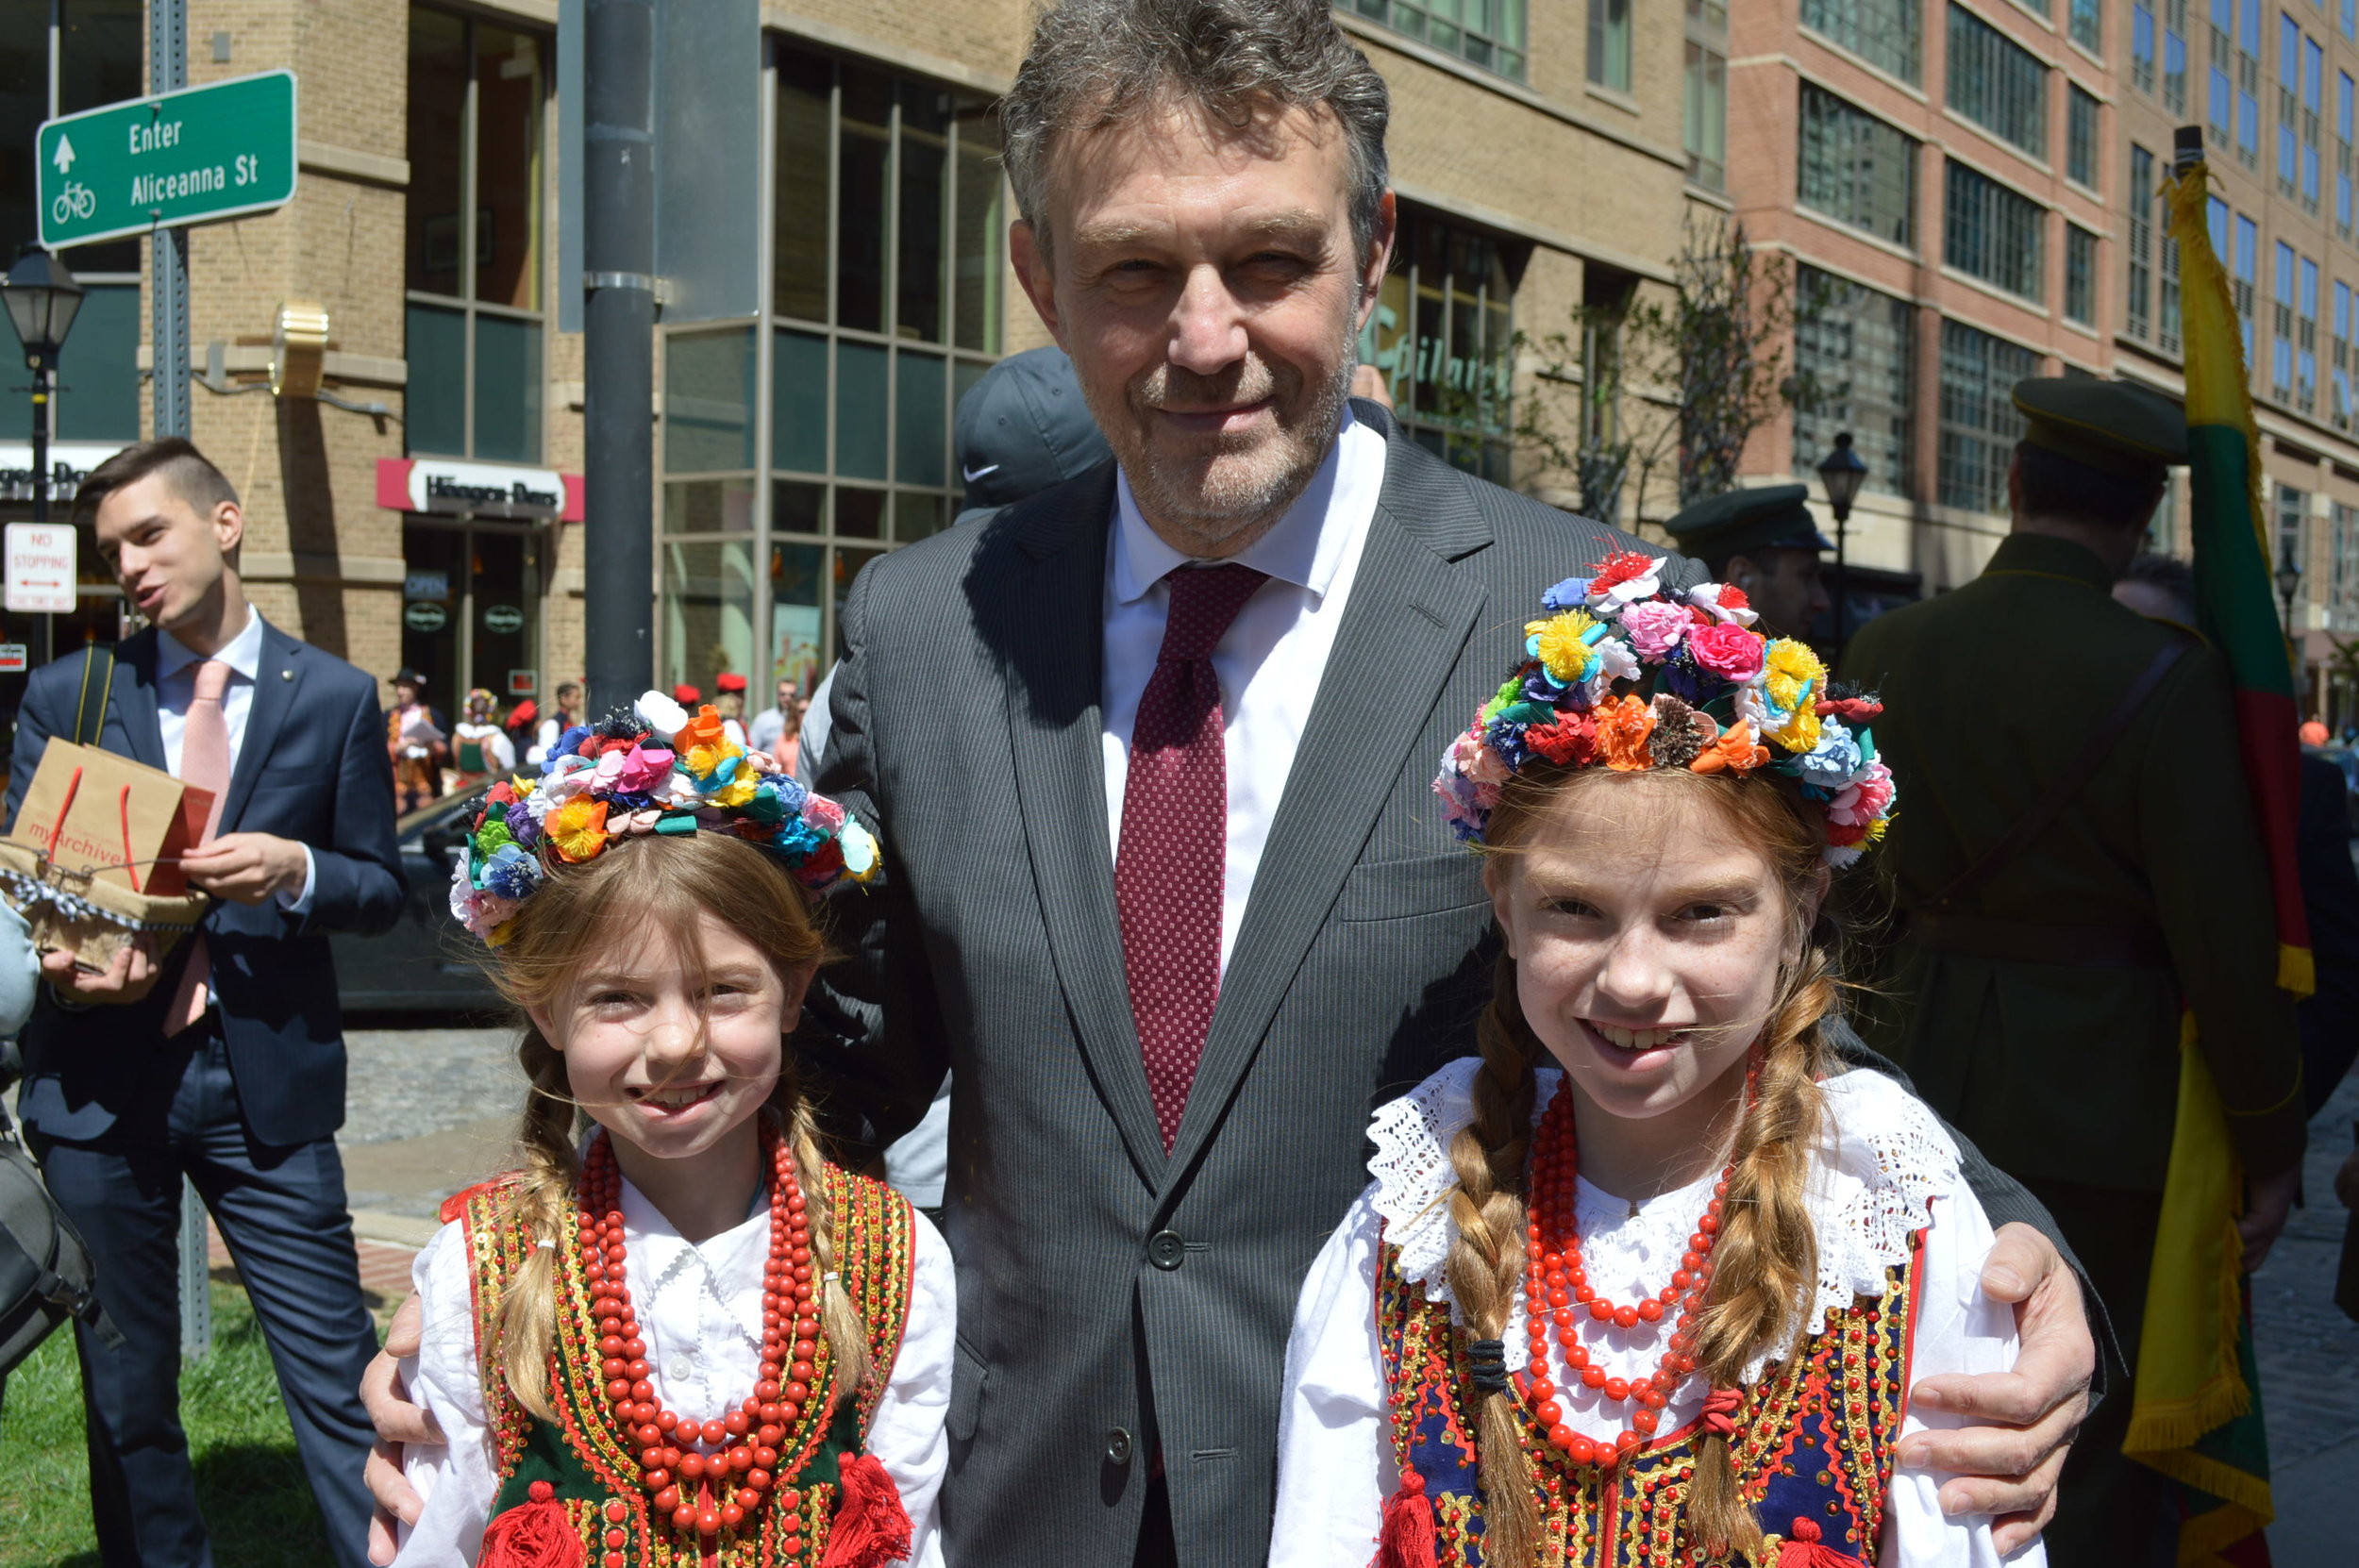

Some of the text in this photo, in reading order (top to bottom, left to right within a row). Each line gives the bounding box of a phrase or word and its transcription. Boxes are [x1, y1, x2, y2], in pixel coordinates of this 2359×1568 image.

[129, 120, 183, 155] Enter
[130, 153, 259, 207] Aliceanna St
[30, 533, 52, 547] NO
[14, 554, 68, 570] STOPPING
